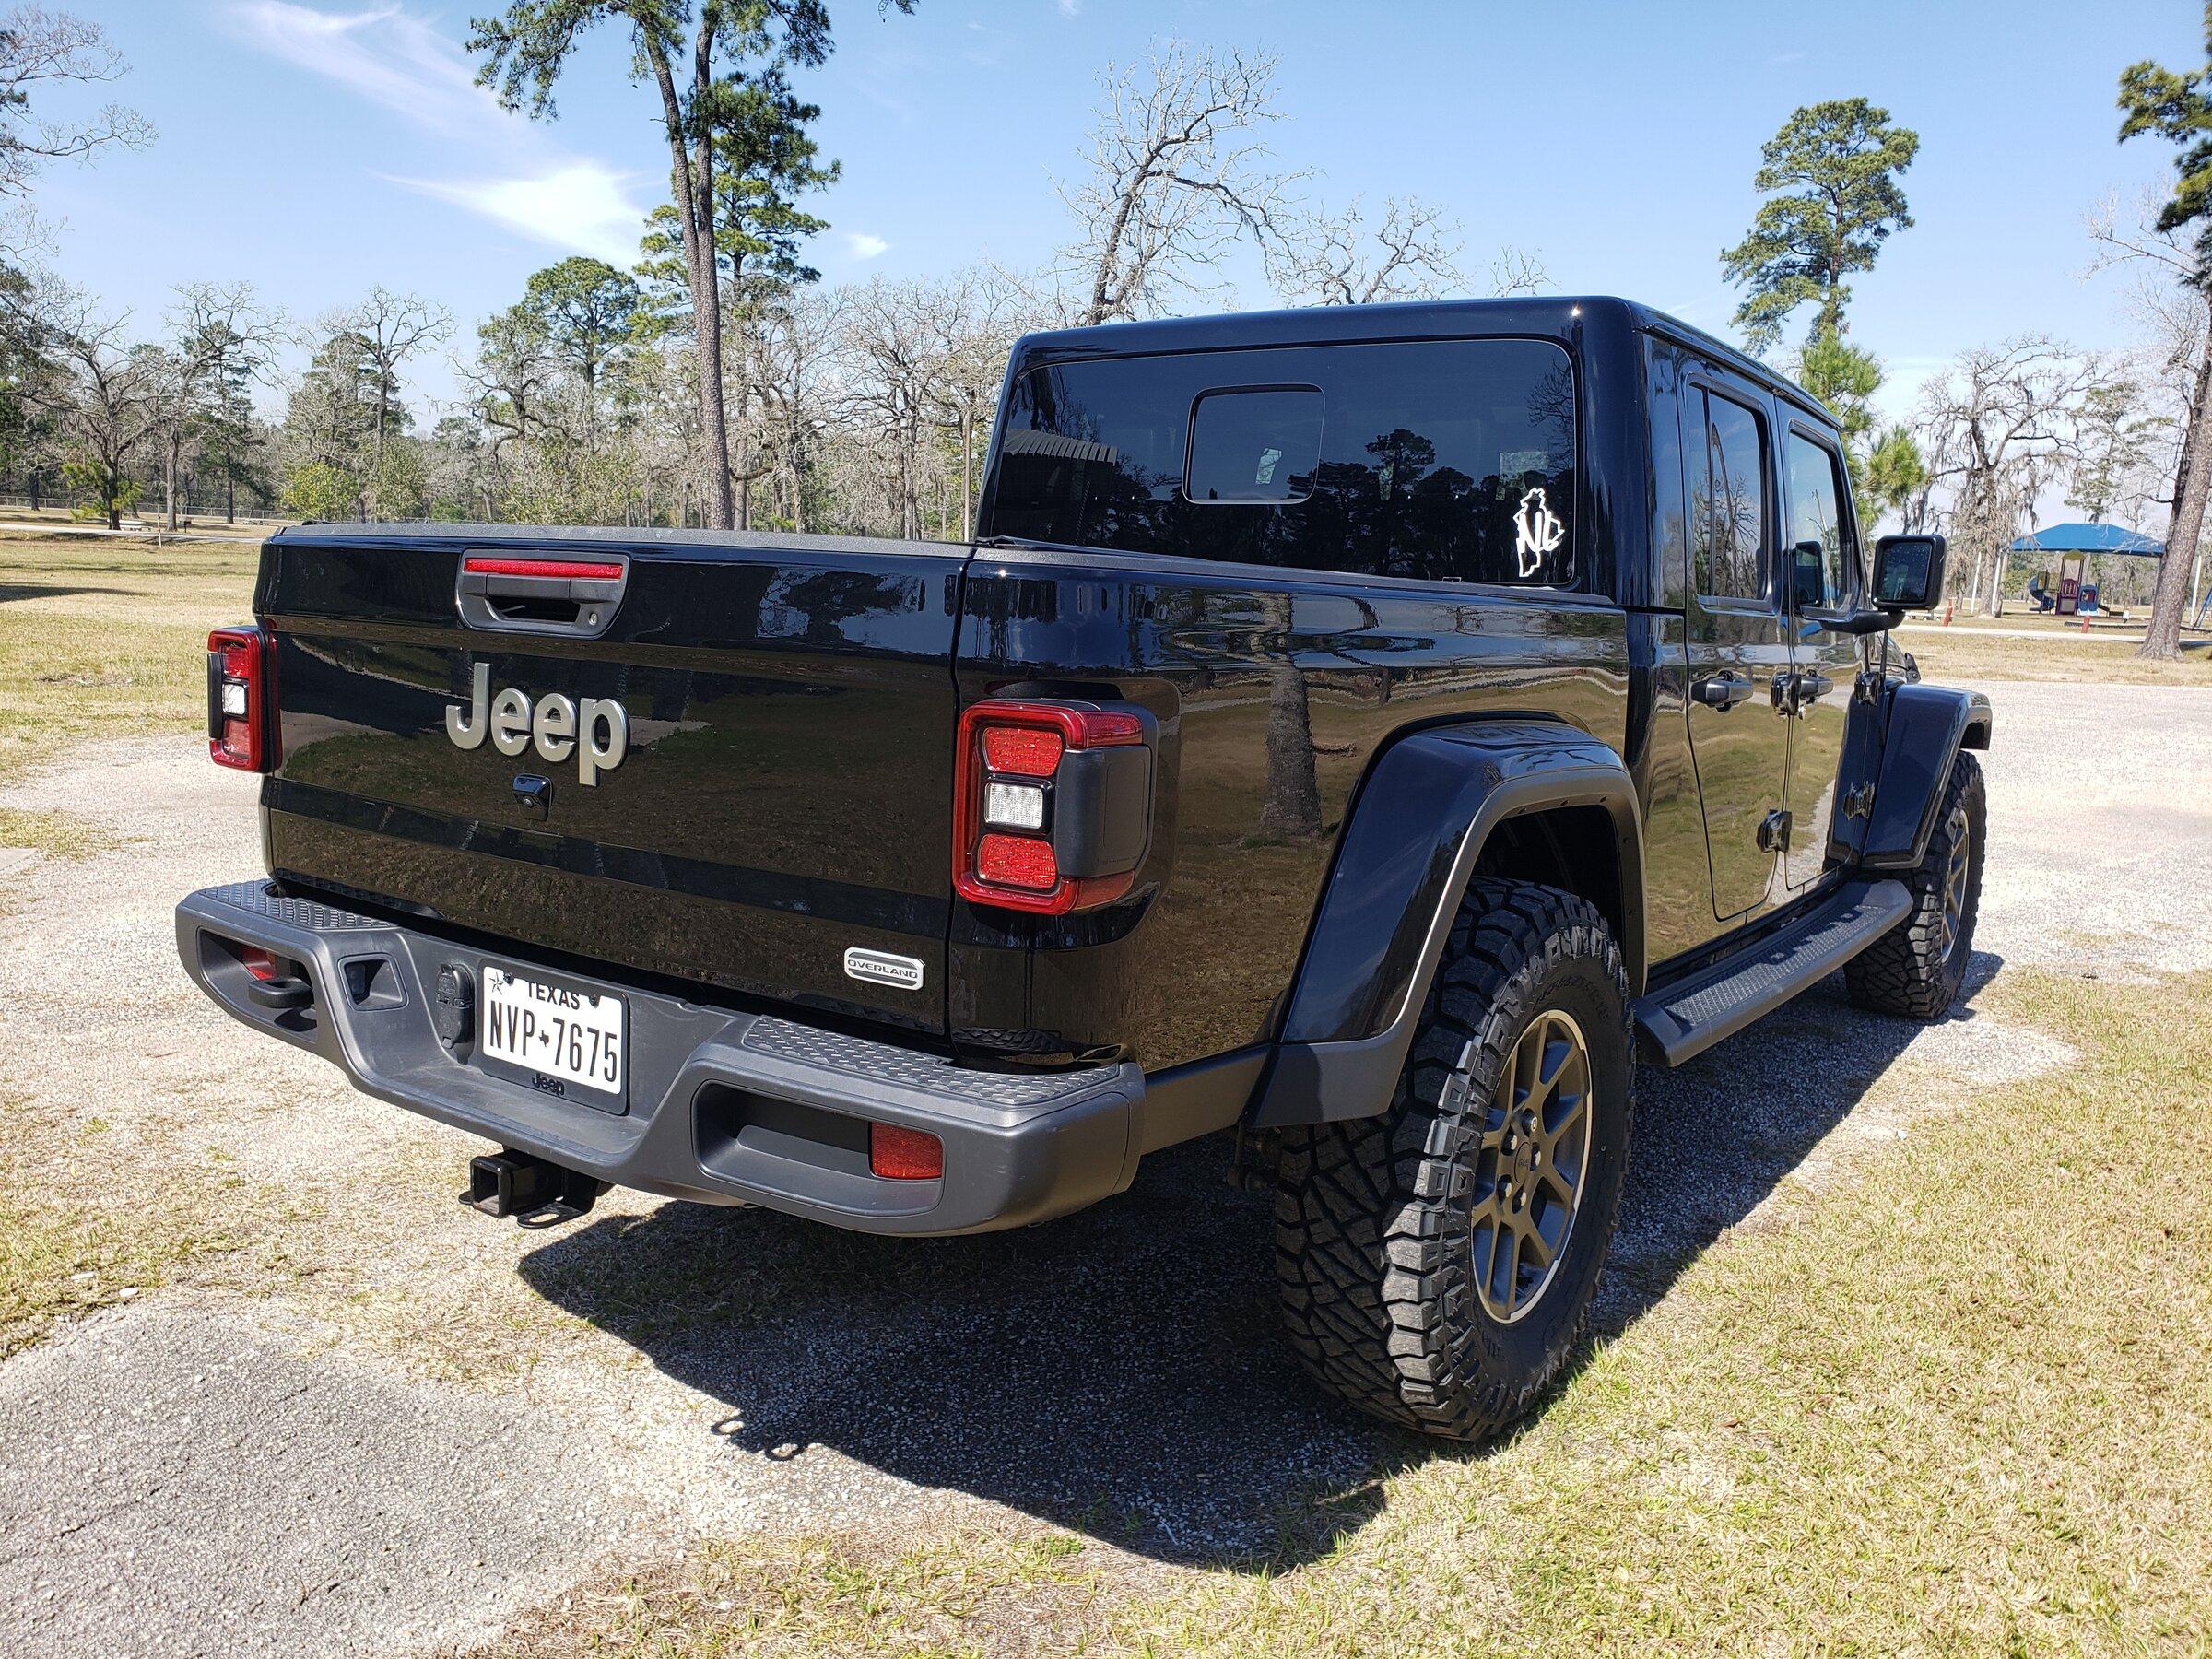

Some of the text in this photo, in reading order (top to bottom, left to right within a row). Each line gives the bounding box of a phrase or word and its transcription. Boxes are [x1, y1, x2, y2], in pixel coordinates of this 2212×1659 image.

[446, 663, 629, 786] Jeep
[848, 959, 918, 979] OVERLAND
[527, 982, 581, 1010] TEXAS
[532, 1073, 564, 1096] Jeep
